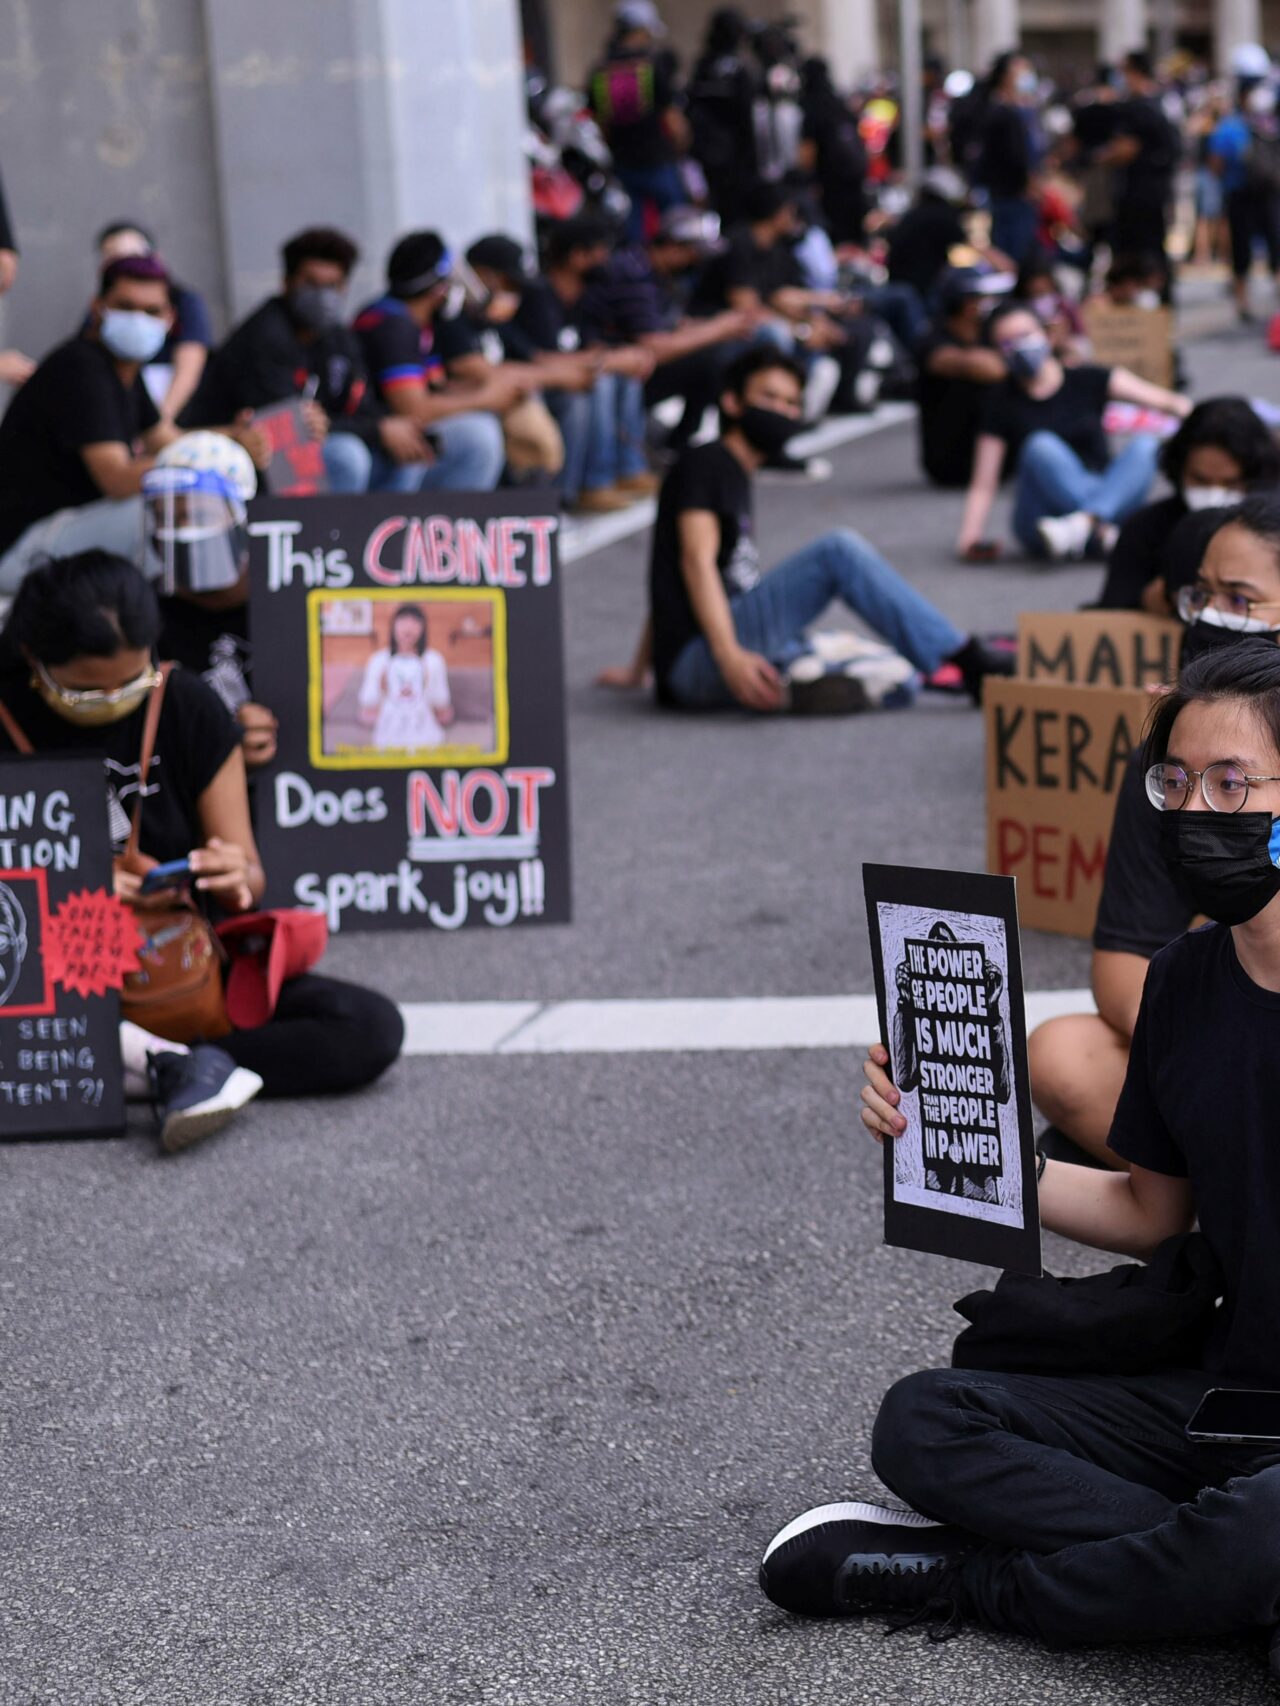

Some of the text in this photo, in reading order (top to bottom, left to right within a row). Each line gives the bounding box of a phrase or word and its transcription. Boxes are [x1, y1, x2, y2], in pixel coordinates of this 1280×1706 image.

[248, 515, 559, 591] This CABINET
[994, 705, 1134, 794] KERA
[274, 767, 557, 837] Does NOT
[0, 834, 80, 872] TION
[295, 860, 545, 933] spark joy!!
[907, 944, 984, 980] THE POWER
[911, 978, 988, 1017] OF PEOPLE
[913, 995, 926, 1011] THE
[17, 1015, 88, 1042] SEEN
[915, 1016, 992, 1061] IS MUCH
[17, 1046, 95, 1075] BEING
[919, 1059, 995, 1096] STRONGER
[922, 1093, 939, 1107] THAN
[923, 1095, 996, 1128] THE PEOPLE
[925, 1127, 937, 1159] IN
